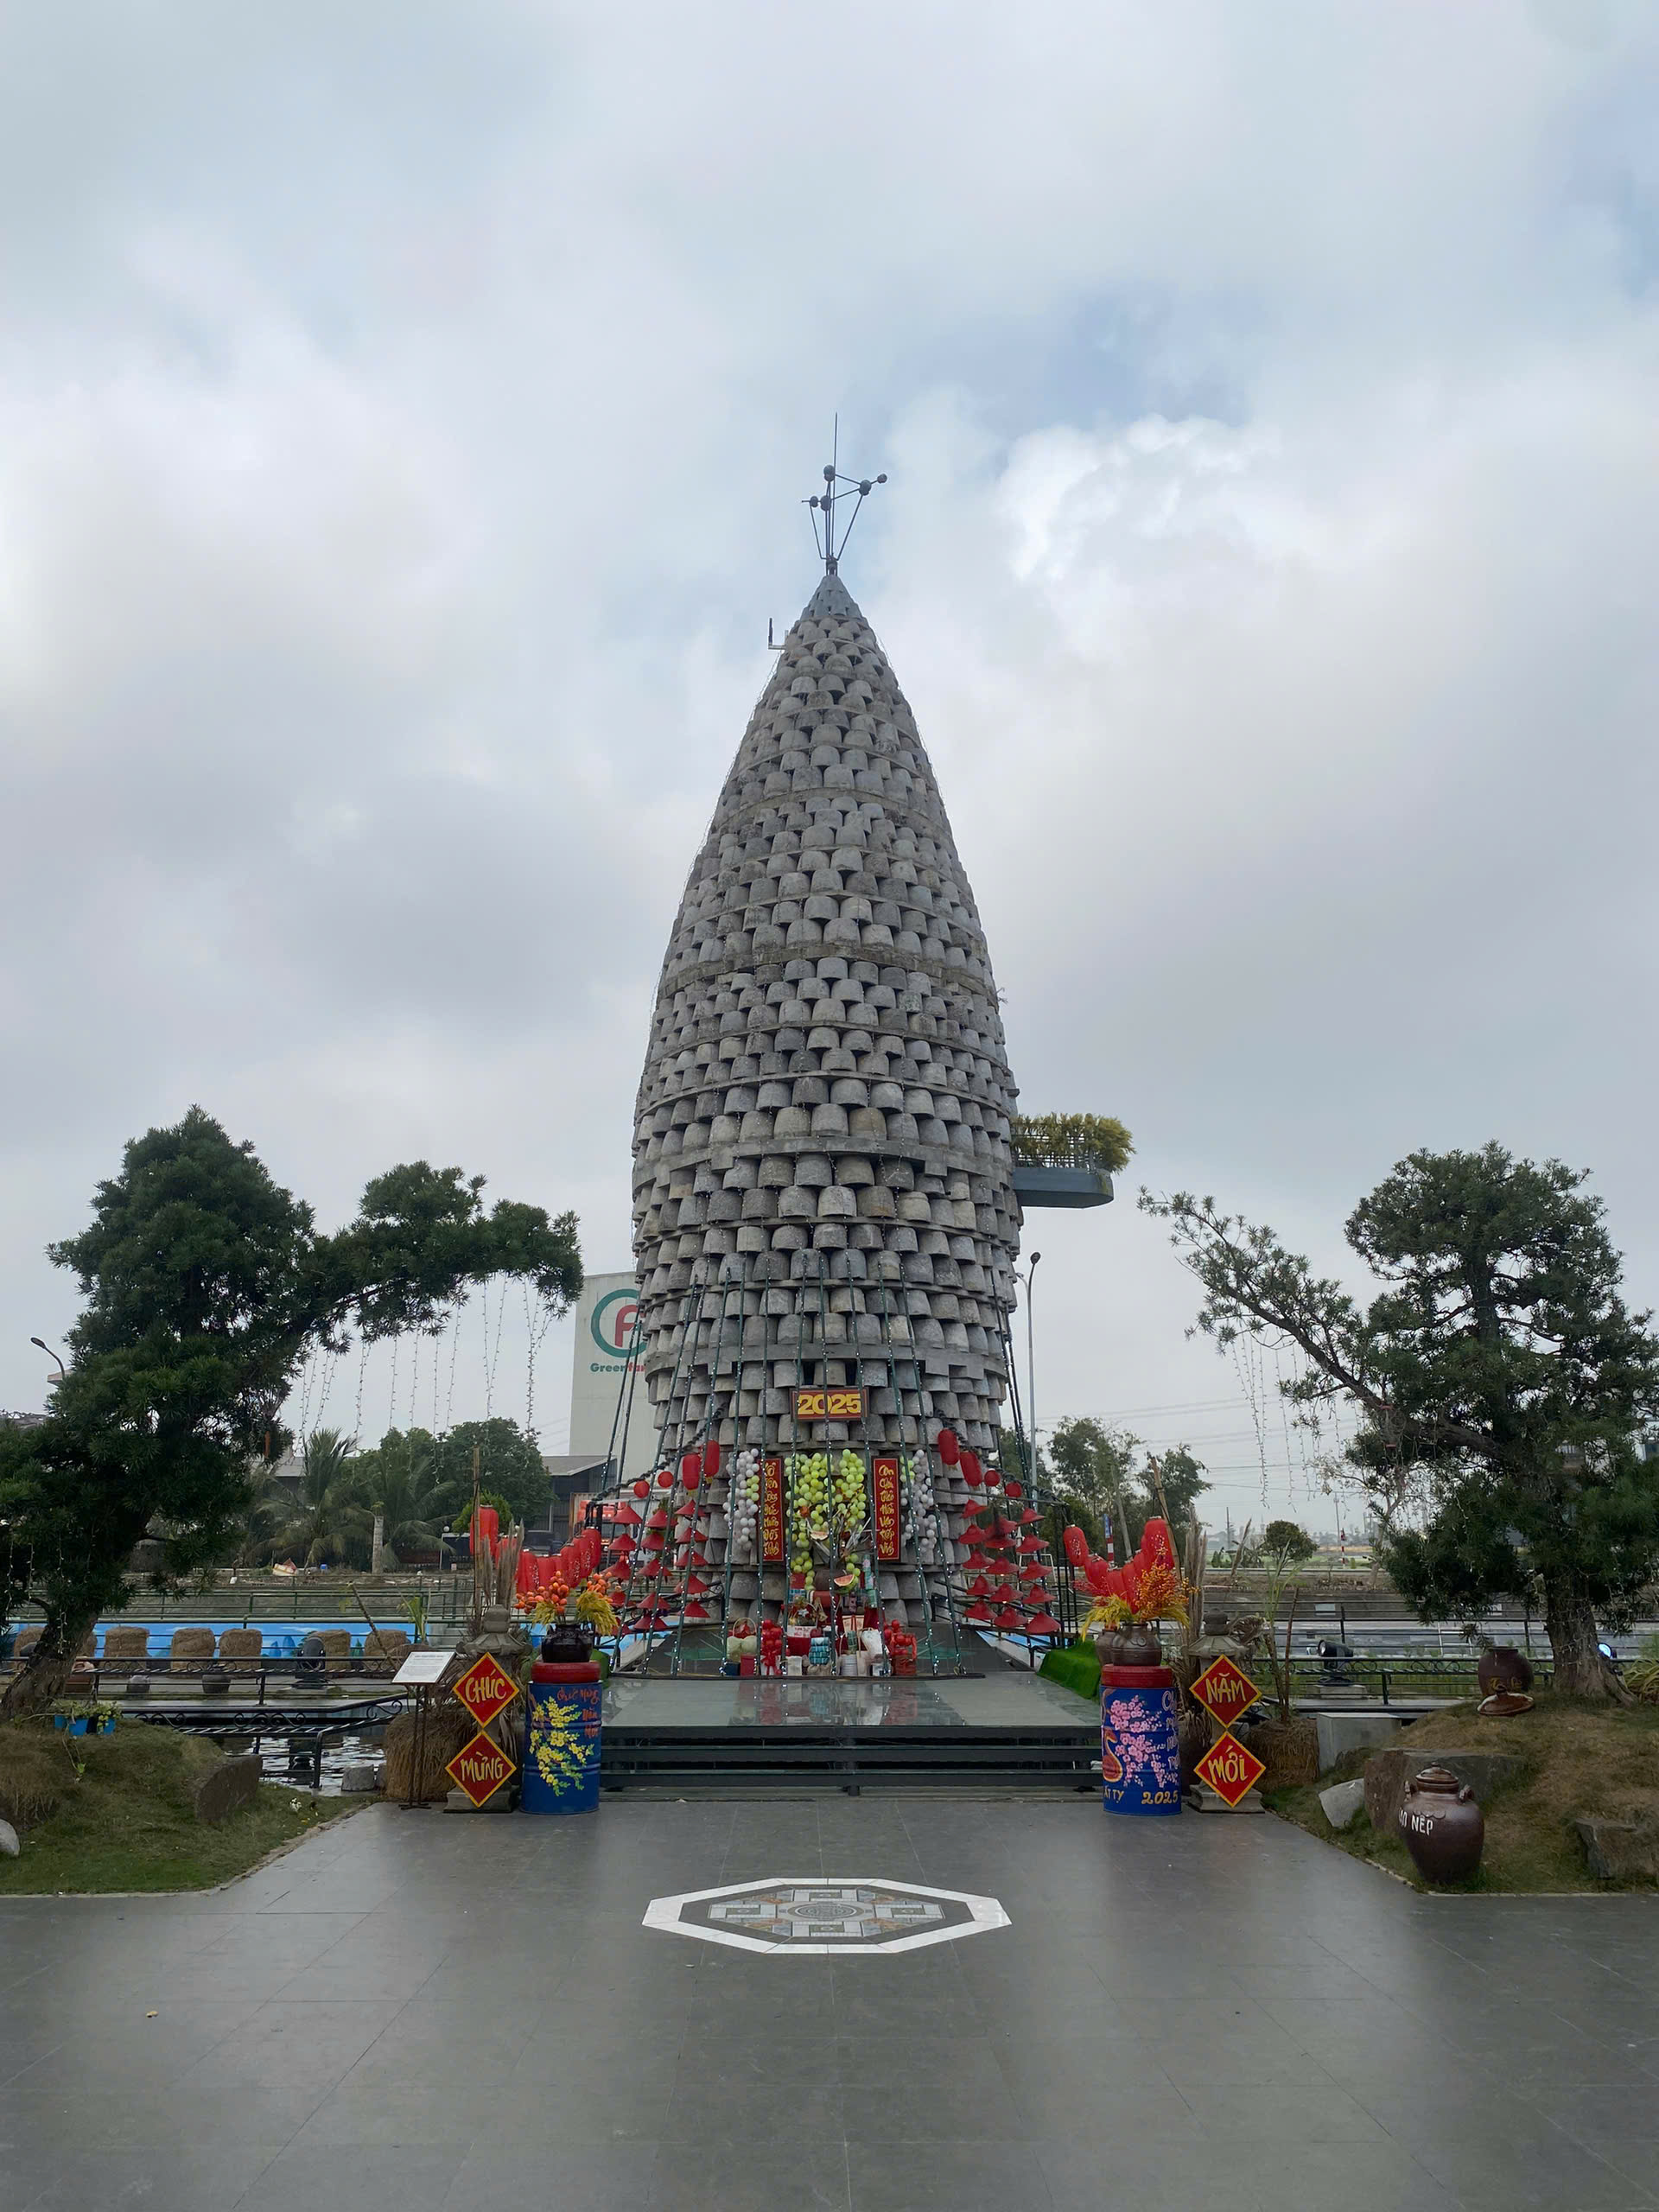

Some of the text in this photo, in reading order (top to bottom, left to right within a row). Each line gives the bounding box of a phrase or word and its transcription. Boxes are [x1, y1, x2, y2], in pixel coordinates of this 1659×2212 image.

[798, 1394, 861, 1414] 2025
[878, 1465, 894, 1477] Con
[465, 1669, 507, 1703] CHÚC
[1205, 1672, 1247, 1704] NĂM
[460, 1751, 505, 1783] MỪNG
[1141, 1789, 1179, 1805] 2025
